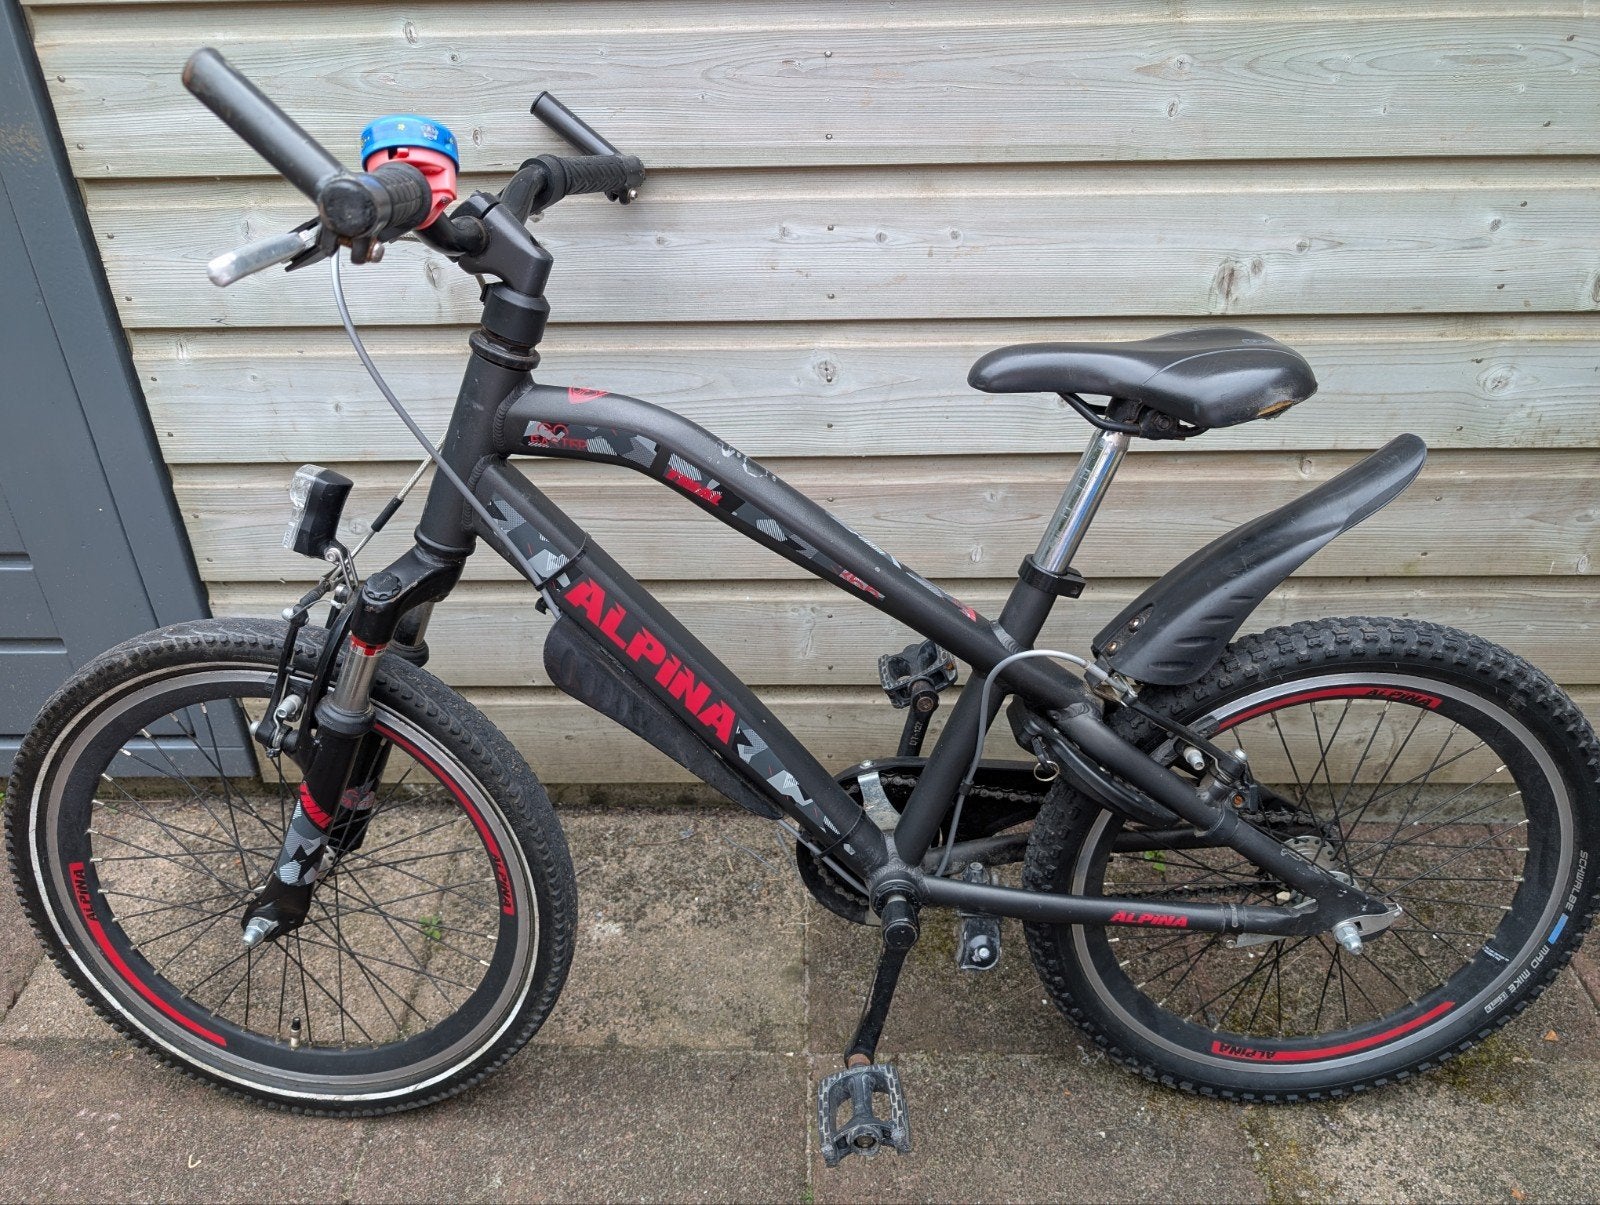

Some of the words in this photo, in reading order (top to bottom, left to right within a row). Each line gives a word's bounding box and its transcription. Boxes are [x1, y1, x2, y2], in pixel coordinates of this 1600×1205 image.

[564, 577, 736, 745] ALPINA
[1364, 689, 1433, 705] ALPINA
[493, 855, 512, 908] ALPINA
[1565, 850, 1588, 912] SCHWALBE
[73, 869, 98, 922] ALPINA
[1110, 910, 1189, 928] ALPINA
[1530, 945, 1550, 969] MAD
[1508, 969, 1531, 993] MIKE
[1219, 1042, 1275, 1059] ALPINA
